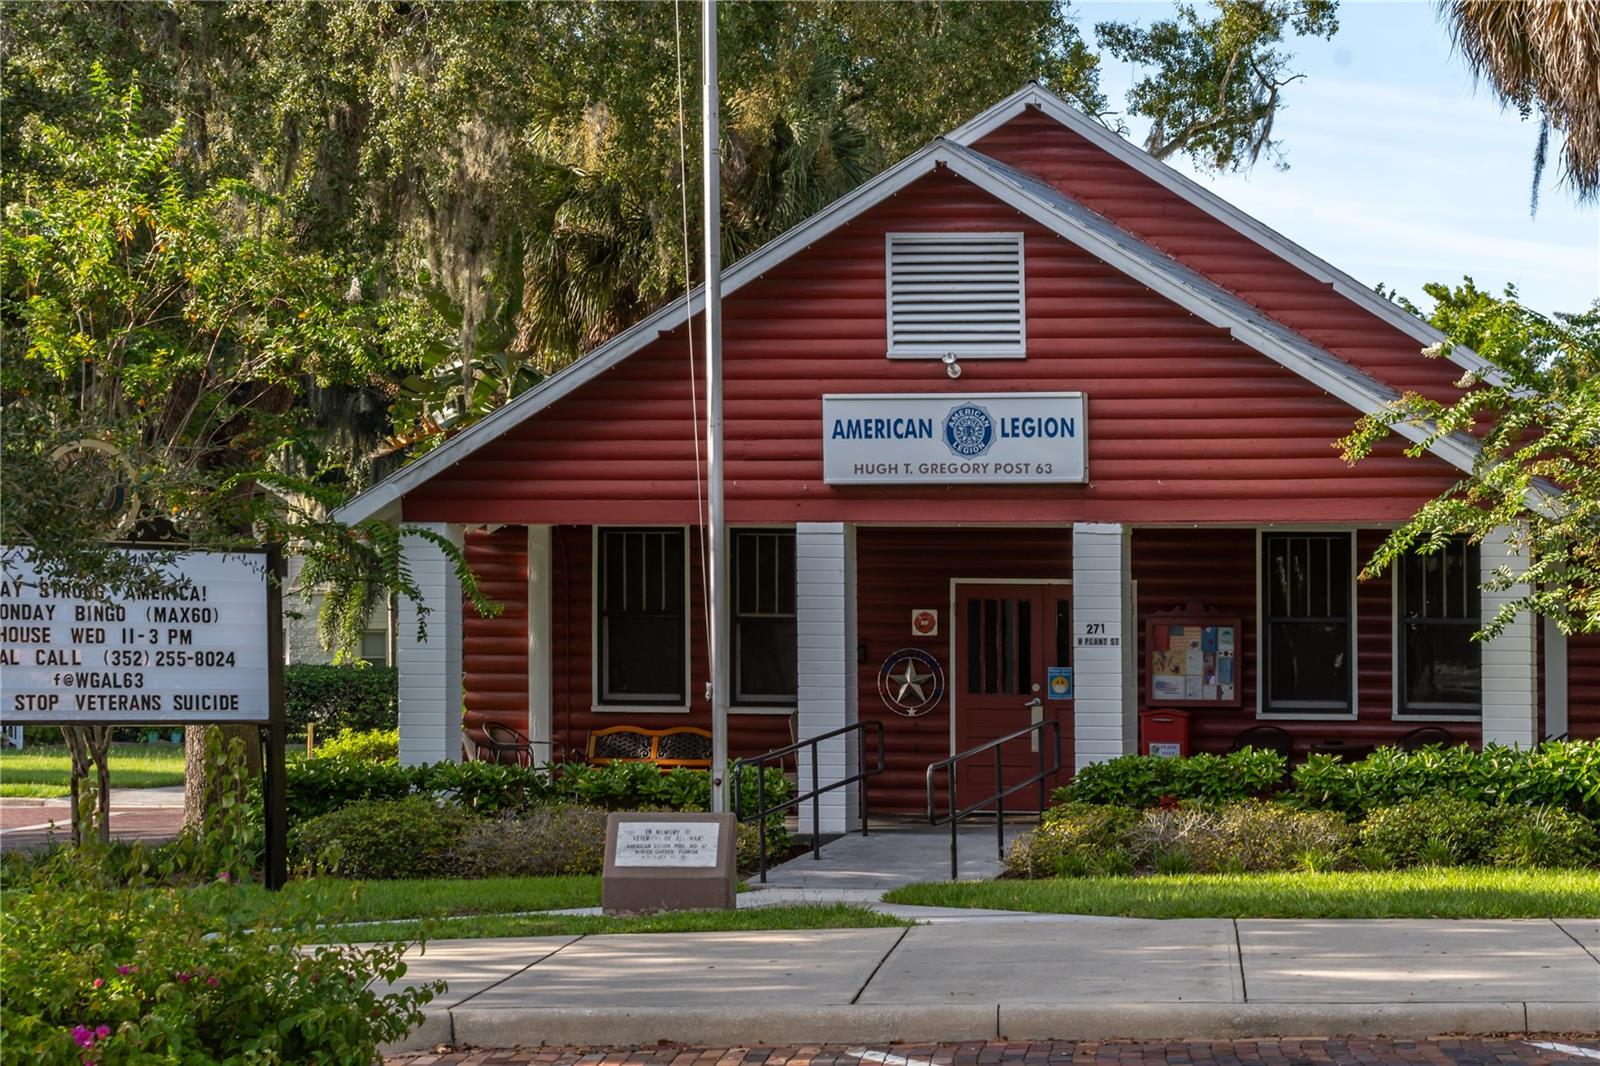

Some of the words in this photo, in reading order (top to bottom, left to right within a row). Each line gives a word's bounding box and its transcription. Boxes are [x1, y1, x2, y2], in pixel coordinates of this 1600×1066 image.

[949, 408, 990, 428] AMERICAN
[832, 418, 933, 440] AMERICAN
[1001, 417, 1074, 438] LEGION
[952, 441, 985, 454] LEGION
[854, 463, 898, 475] HUGH
[903, 463, 913, 474] T.
[919, 463, 990, 474] GREGORY
[994, 463, 1032, 474] POST
[1036, 463, 1053, 474] 63
[39, 582, 104, 598] STROG
[75, 605, 126, 622] BINGO
[146, 606, 219, 624] (MAX60)
[71, 628, 106, 644] WED
[168, 629, 192, 645] PM
[1086, 623, 1105, 634] 271
[36, 649, 81, 666] CALL
[103, 650, 149, 667] (352)
[155, 651, 235, 667] 255-8024
[14, 694, 59, 711] STOP
[75, 694, 161, 711] VETERANS
[173, 695, 239, 711] SUICIDE
